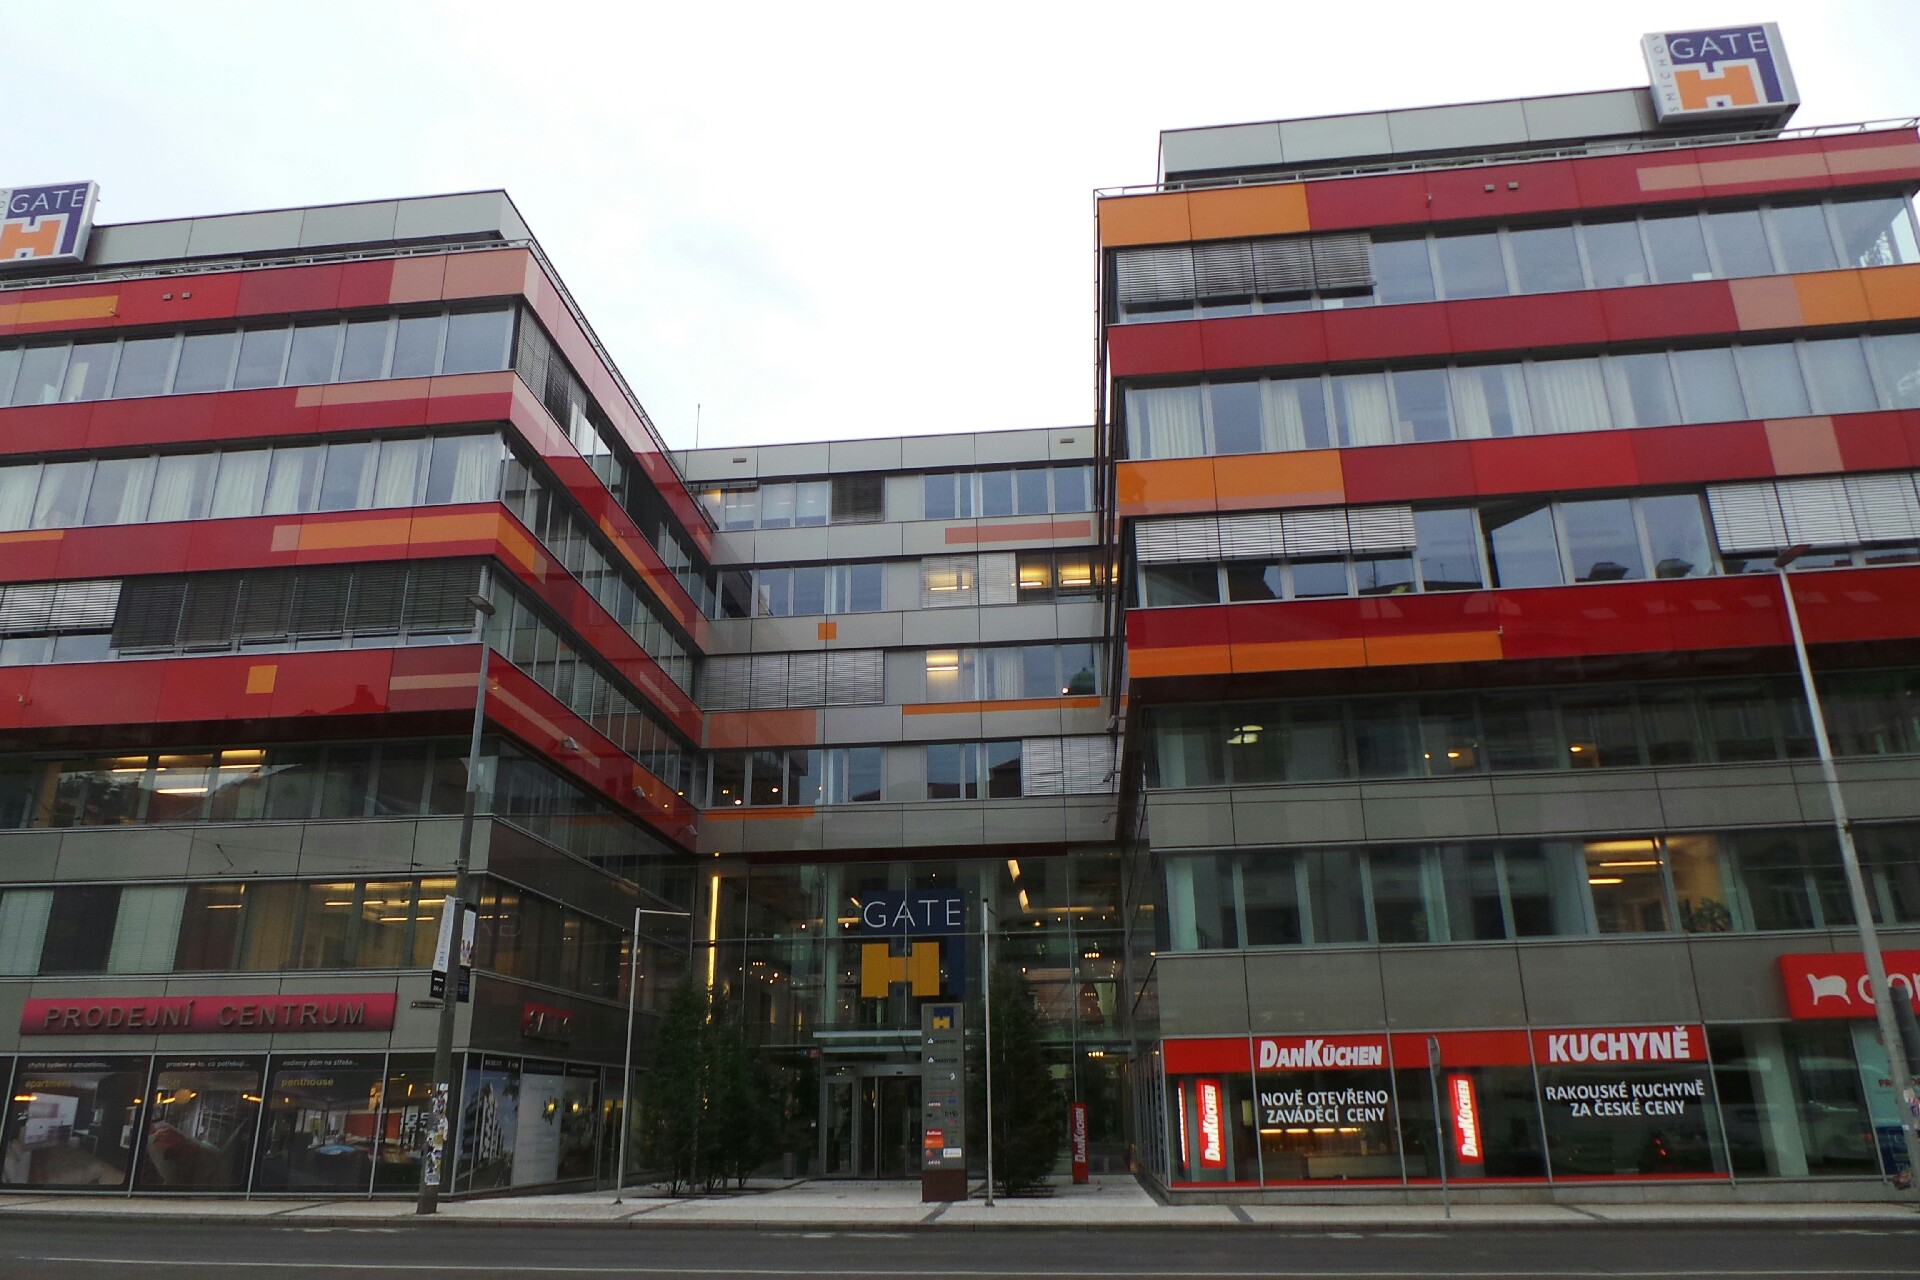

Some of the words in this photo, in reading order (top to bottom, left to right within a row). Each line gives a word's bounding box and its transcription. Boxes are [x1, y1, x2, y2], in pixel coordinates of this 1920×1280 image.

[1669, 31, 1768, 59] GATE
[10, 188, 86, 213] GATE
[863, 899, 961, 928] GATE
[43, 1000, 196, 1029] PRODEJNÍ
[218, 1002, 366, 1027] CENTRUM
[1549, 1025, 1691, 1063] KUCHYNĚ
[281, 1078, 335, 1088] penthouse
[1545, 1080, 1629, 1101] RAKOUSKÉ
[1631, 1078, 1706, 1098] KUCHYNĚ
[1261, 1088, 1304, 1107] NOVĚ
[1306, 1087, 1389, 1106] OTEVŘENO
[1570, 1103, 1592, 1118] ZA
[1594, 1098, 1641, 1117] ČESKÉ
[1644, 1100, 1685, 1115] CENY
[1266, 1104, 1339, 1124] ZAVÁDĚCÍ
[1346, 1107, 1385, 1122] CENY
